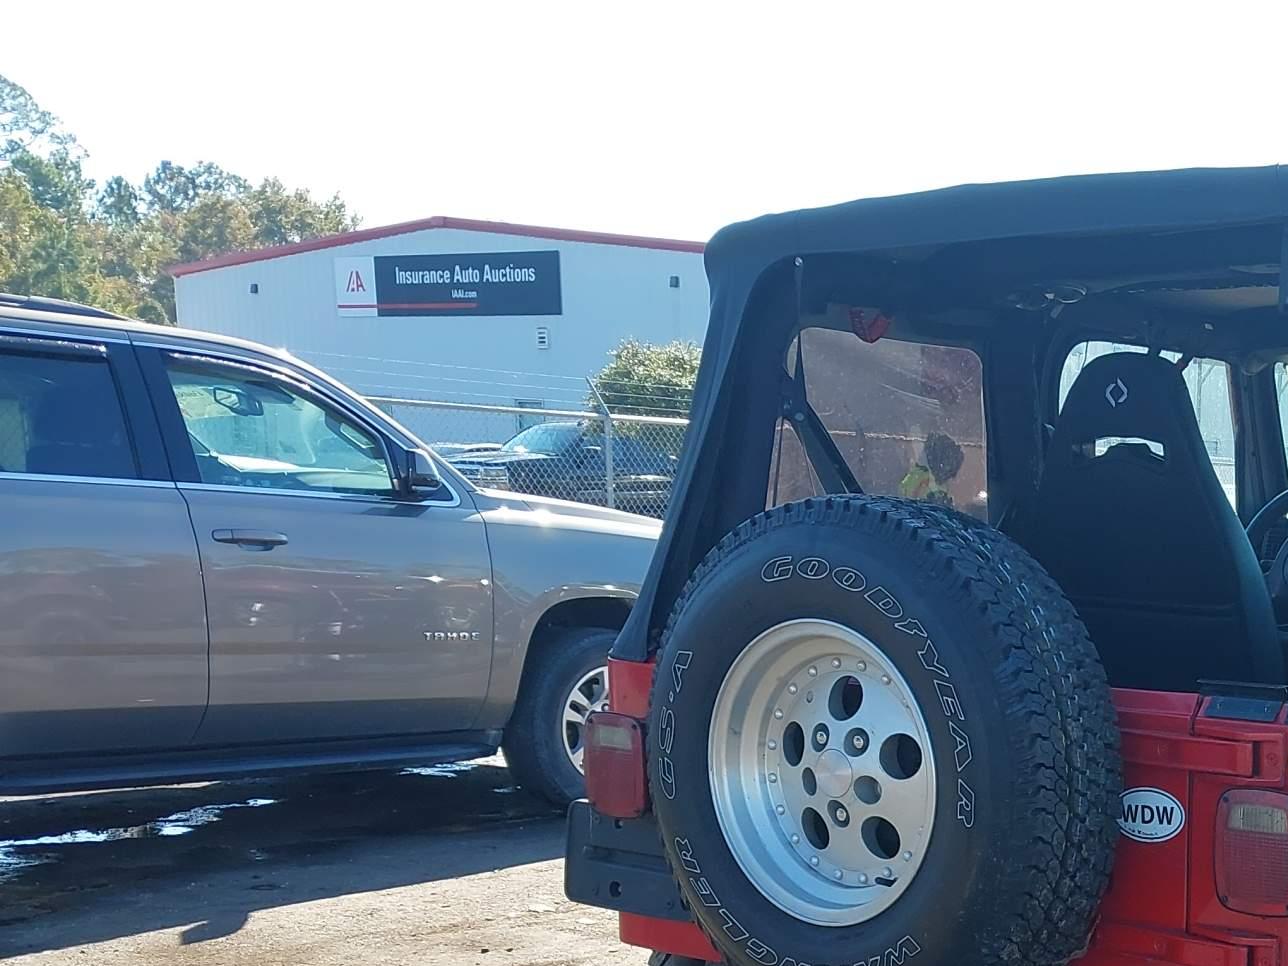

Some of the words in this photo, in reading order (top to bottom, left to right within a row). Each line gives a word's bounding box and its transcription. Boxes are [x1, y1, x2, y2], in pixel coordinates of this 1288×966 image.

[395, 266, 452, 285] Insurance
[453, 265, 480, 283] Auto
[482, 263, 536, 282] Auctions
[423, 631, 481, 641] TAHOE
[761, 555, 976, 828] GOODYEAR
[1121, 803, 1175, 826] WDW
